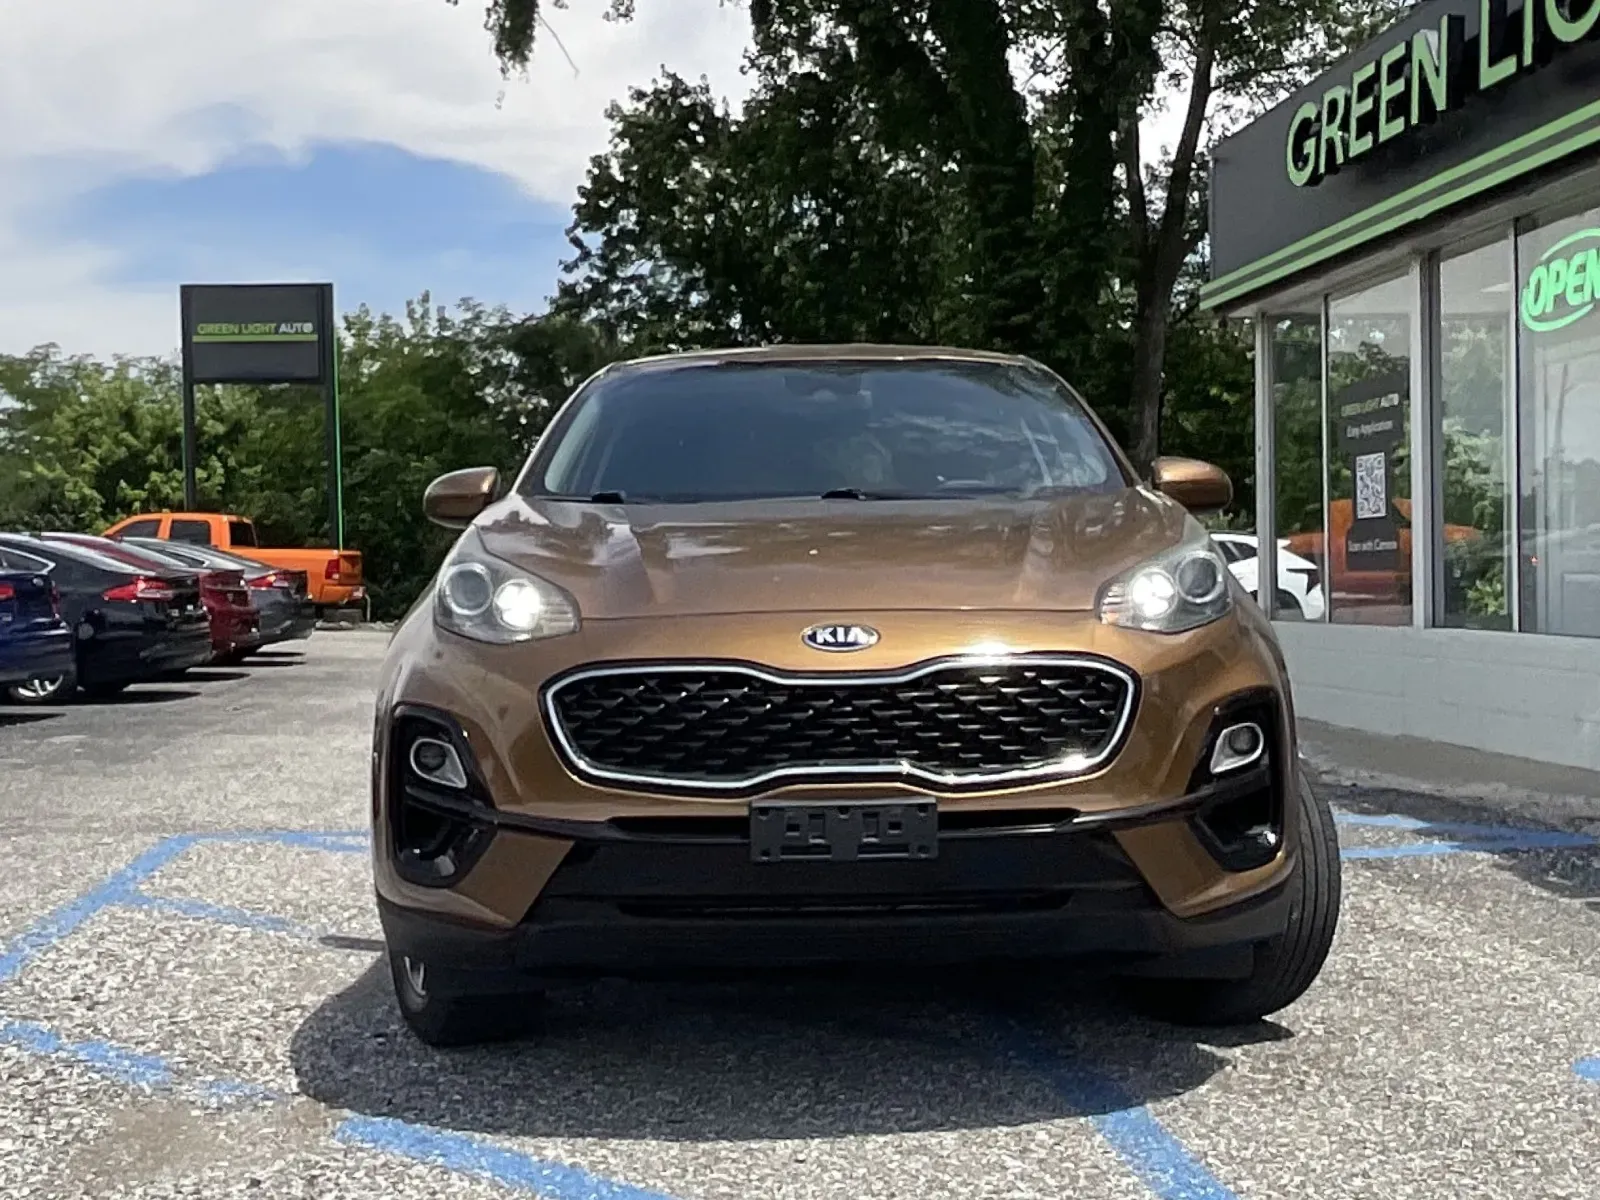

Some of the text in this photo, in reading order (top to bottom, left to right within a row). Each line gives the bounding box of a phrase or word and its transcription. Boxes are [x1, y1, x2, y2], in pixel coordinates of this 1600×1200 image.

[1286, 15, 1450, 187] GREEN
[197, 322, 313, 334] GREEN LIGHT AUTO
[815, 626, 871, 644] KIA
